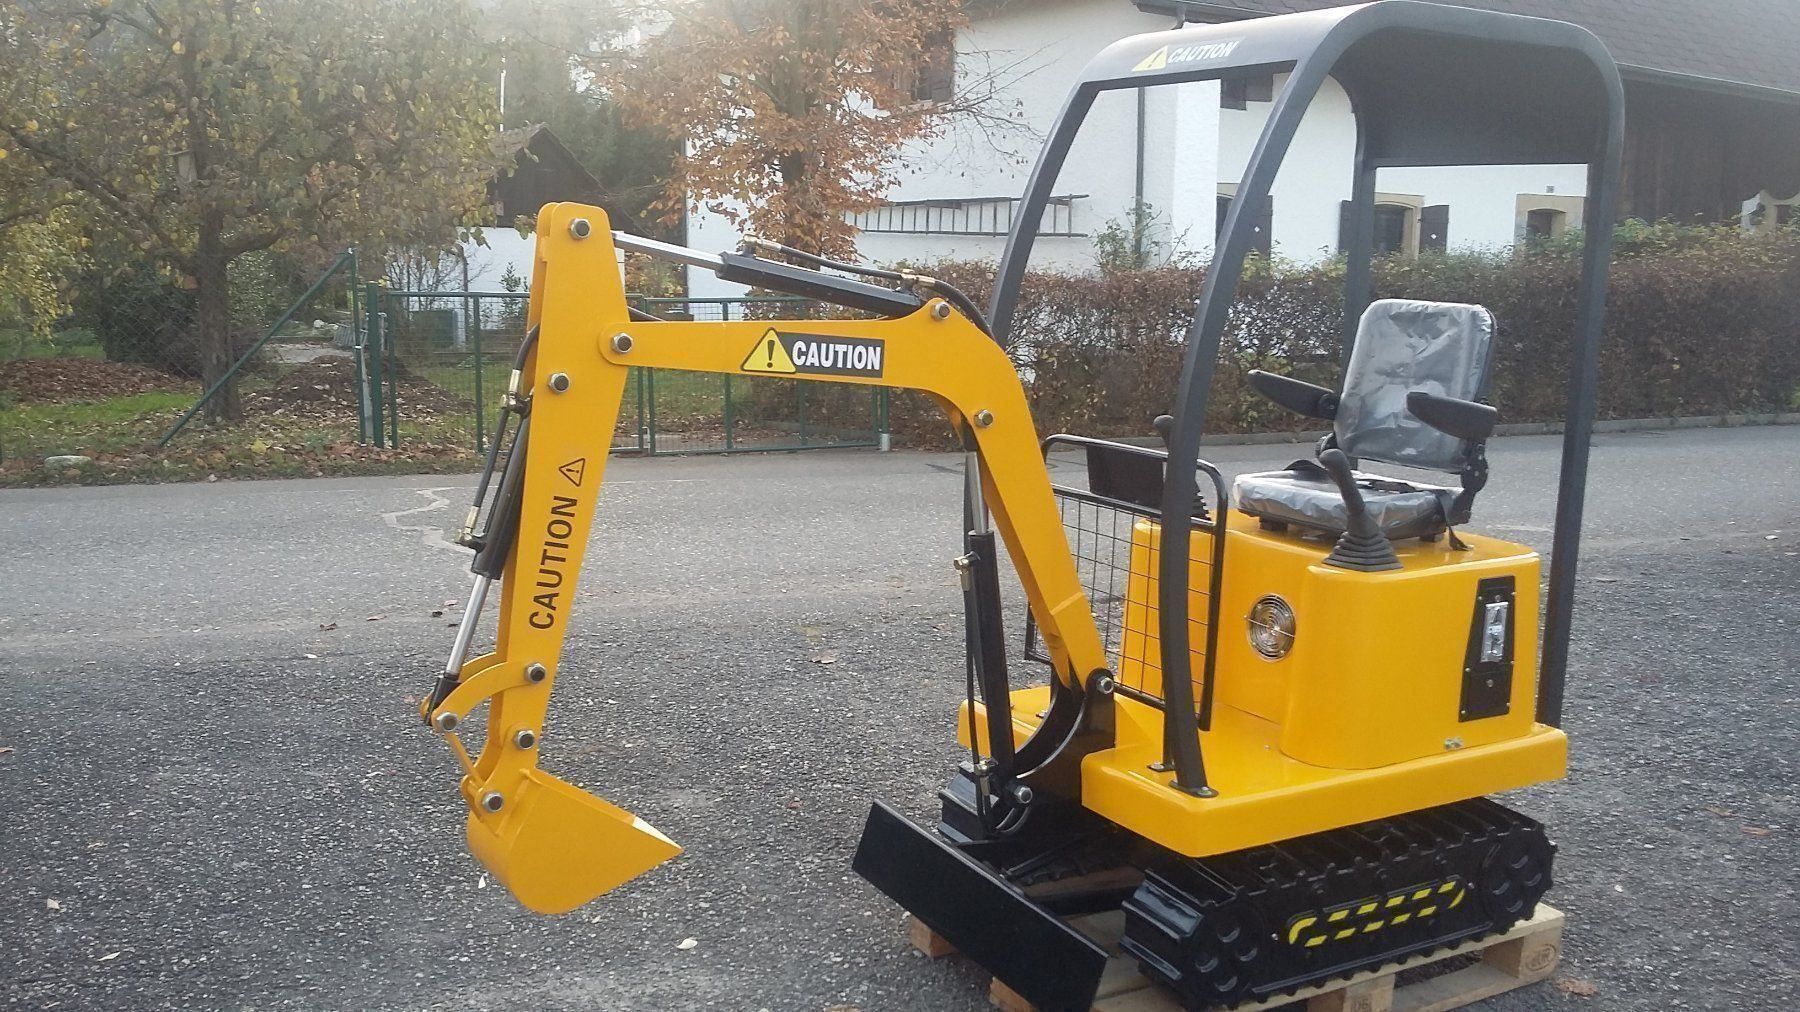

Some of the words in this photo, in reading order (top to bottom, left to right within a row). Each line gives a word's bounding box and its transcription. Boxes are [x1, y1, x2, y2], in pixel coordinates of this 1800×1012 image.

[1168, 41, 1239, 63] CAUTION
[792, 340, 881, 370] CAUTION
[529, 496, 578, 629] CAUTION
